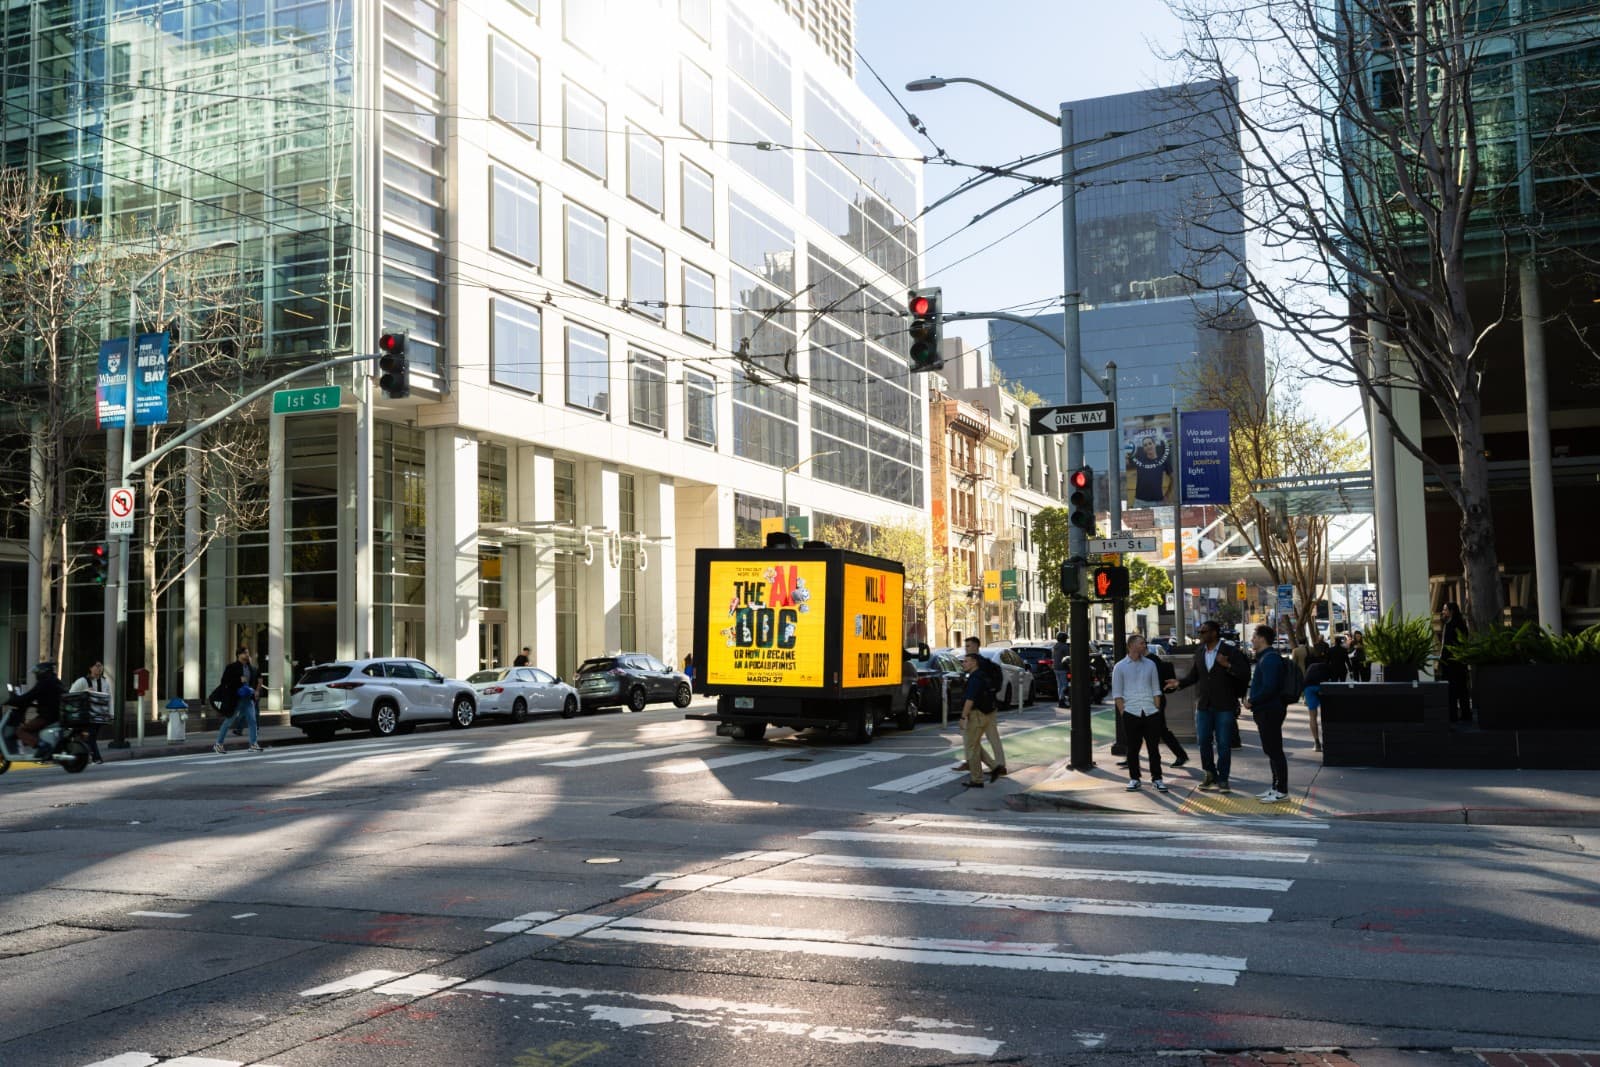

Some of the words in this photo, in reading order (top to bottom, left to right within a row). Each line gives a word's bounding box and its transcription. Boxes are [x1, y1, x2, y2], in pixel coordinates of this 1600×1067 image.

[138, 354, 166, 368] MBA
[99, 374, 126, 383] Wharton
[144, 370, 166, 382] BAY
[288, 394, 304, 408] 1st
[313, 393, 327, 405] St
[1054, 414, 1076, 424] ONE
[1081, 412, 1104, 423] WAY
[1188, 467, 1205, 476] light.
[120, 520, 132, 529] RED
[1102, 541, 1117, 549] 1st
[1128, 540, 1142, 549] St
[734, 581, 766, 606] THE
[769, 566, 798, 607] AI
[866, 576, 878, 602] WILL
[880, 575, 886, 603] AI
[736, 608, 798, 649] DOC
[862, 614, 876, 640] TAKE
[877, 616, 886, 640] ALL
[734, 650, 743, 659] OR
[745, 650, 760, 659] HOW
[762, 650, 765, 659] I
[767, 650, 796, 660] BECAME
[734, 661, 742, 669] AN
[744, 661, 796, 670] APOCALOPTIMIST
[858, 653, 870, 678] OUR
[871, 653, 889, 678] JOBS?
